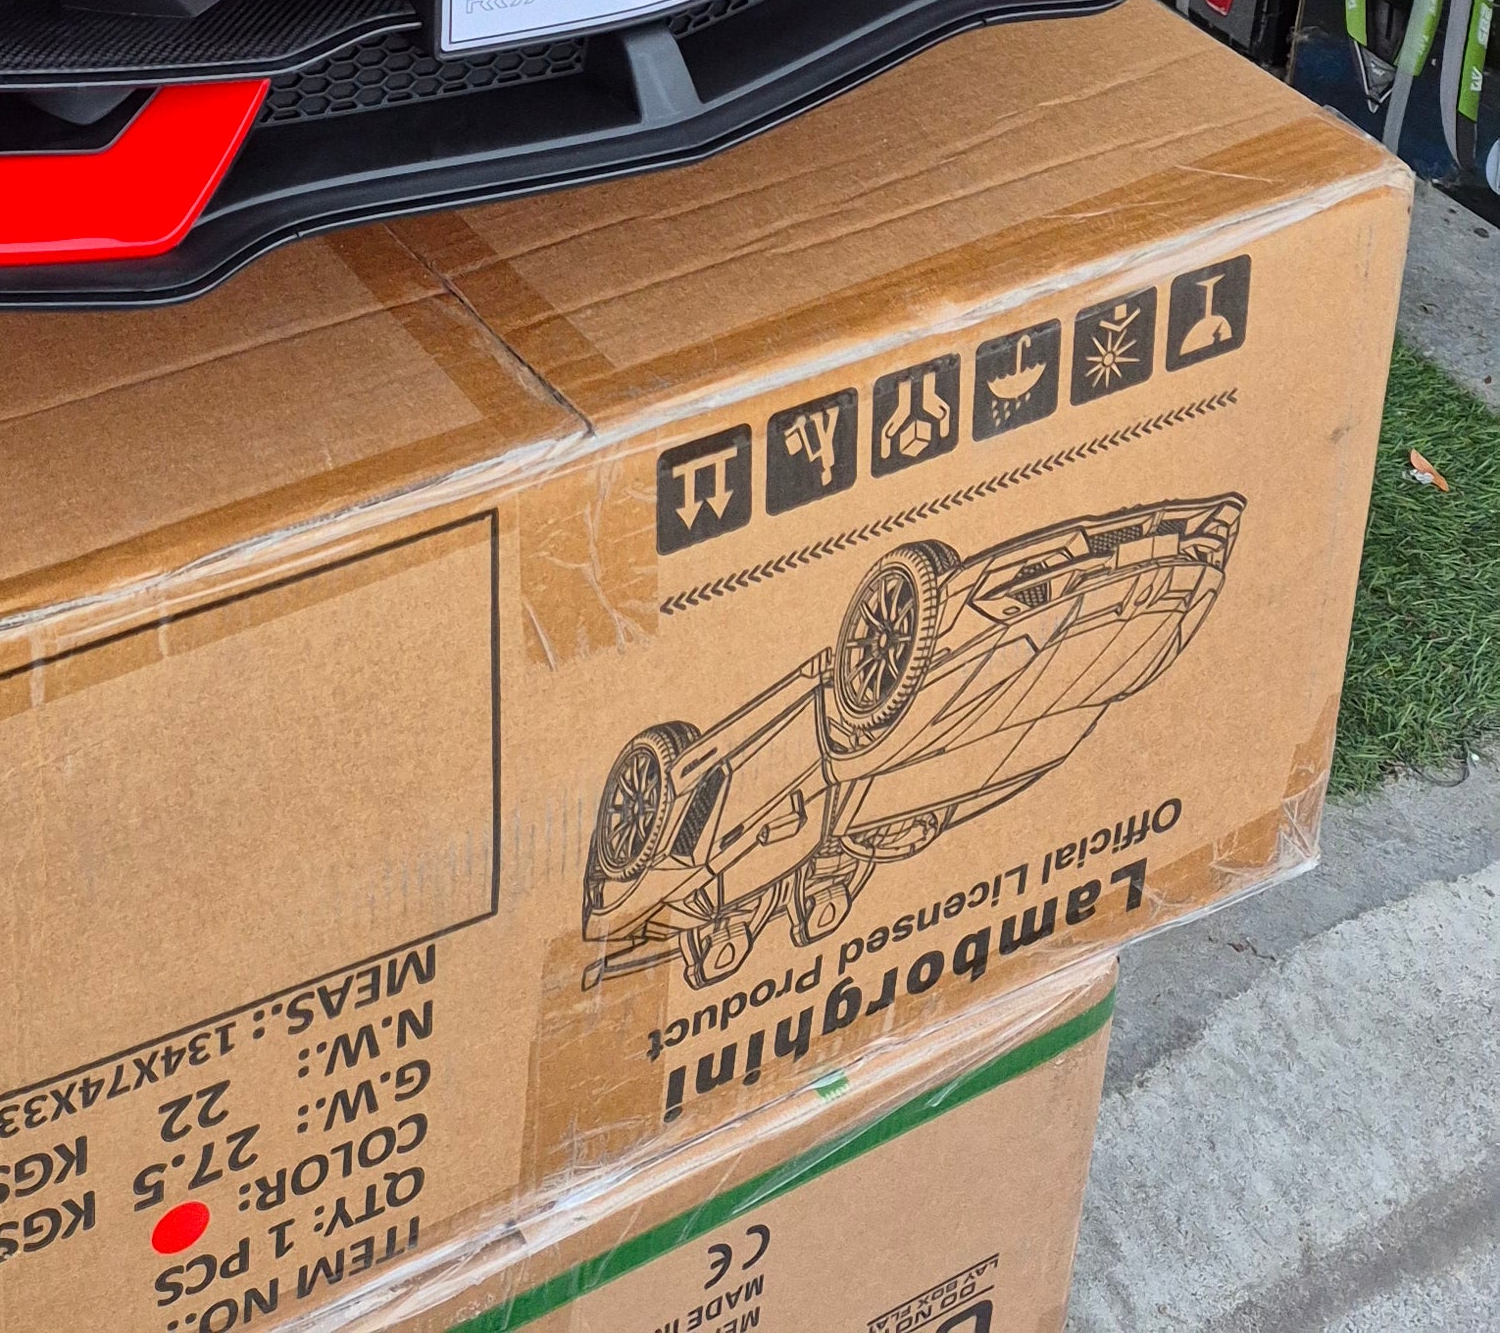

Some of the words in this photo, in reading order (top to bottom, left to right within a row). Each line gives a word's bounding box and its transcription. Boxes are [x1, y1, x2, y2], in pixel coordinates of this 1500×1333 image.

[1040, 797, 1183, 886] Official
[838, 862, 1028, 966] Licensed
[645, 954, 824, 1061] Product
[663, 856, 1150, 1124] Lamborghini
[297, 1000, 435, 1079] N.W.:
[157, 1079, 232, 1143] 22
[296, 1057, 432, 1134] G.W.:
[132, 1123, 261, 1213] 27.5
[238, 1112, 429, 1213] COLOR:
[270, 1217, 296, 1260] 1
[313, 1166, 426, 1238] QTY:
[154, 1236, 251, 1308] PCS
[296, 1216, 421, 1301] ITEM
[915, 1279, 961, 1308] BOX
[940, 1282, 977, 1311] DO
[962, 1257, 999, 1286] LAY
[688, 1274, 765, 1332] MADE
